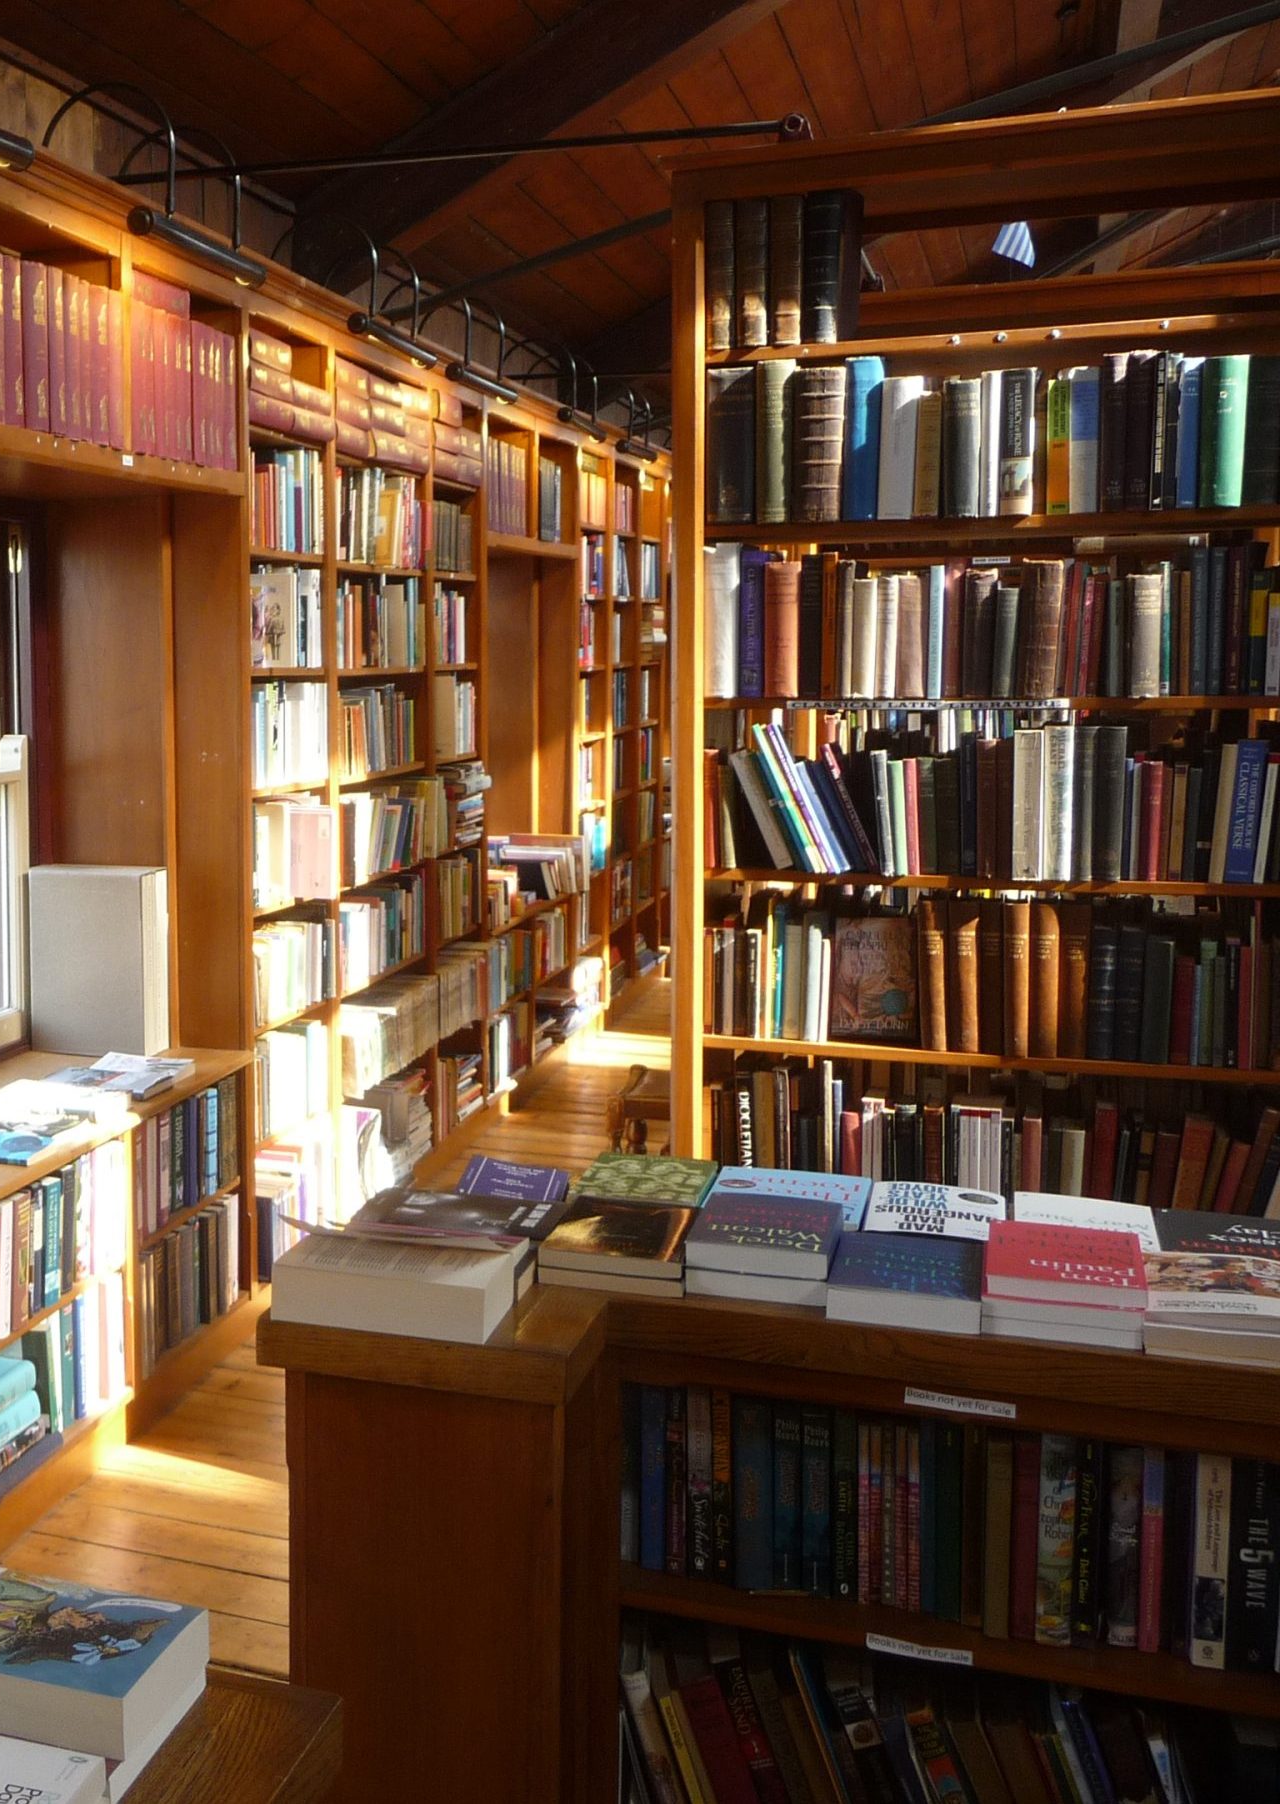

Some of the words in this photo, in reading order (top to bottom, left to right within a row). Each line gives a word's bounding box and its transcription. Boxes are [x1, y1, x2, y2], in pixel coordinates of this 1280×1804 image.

[1014, 395, 1024, 424] LEGACY
[1013, 433, 1024, 457] ROME
[943, 700, 1062, 708] LITERATURE
[1048, 735, 1058, 765] GRANT
[1056, 731, 1066, 769] MICHAEL
[1250, 763, 1260, 778] THE
[1235, 762, 1249, 816] CLASSICAL
[1247, 779, 1259, 812] OXFORD
[1232, 818, 1245, 849] VERSE
[1246, 815, 1256, 836] BOOK
[1244, 838, 1253, 849] OF
[738, 1092, 753, 1168] DIOCLETIAN
[889, 1183, 950, 1194] JOYCE
[706, 1223, 823, 1242] Walcott
[894, 1221, 945, 1233] MAD,
[728, 1235, 821, 1252] Derek
[1208, 1234, 1280, 1247] ssex
[1030, 1259, 1136, 1277] Paulin
[1060, 1272, 1140, 1288] Tom
[906, 1388, 935, 1401] Books
[938, 1393, 954, 1404] not
[957, 1397, 971, 1408] yet
[975, 1401, 989, 1411] for
[992, 1405, 1011, 1415] sale
[775, 1418, 800, 1432] Philip
[804, 1424, 830, 1437] Philip
[775, 1431, 800, 1441] Reeve
[804, 1436, 830, 1447] Reeve
[1247, 1518, 1269, 1544] THE
[1239, 1547, 1275, 1563] 5
[1245, 1568, 1267, 1608] WAVE
[870, 1636, 896, 1650] Books
[898, 1642, 914, 1652] not
[918, 1646, 932, 1656] yet
[934, 1650, 948, 1659] for
[951, 1652, 970, 1662] sale
[727, 1697, 752, 1735] SAND
